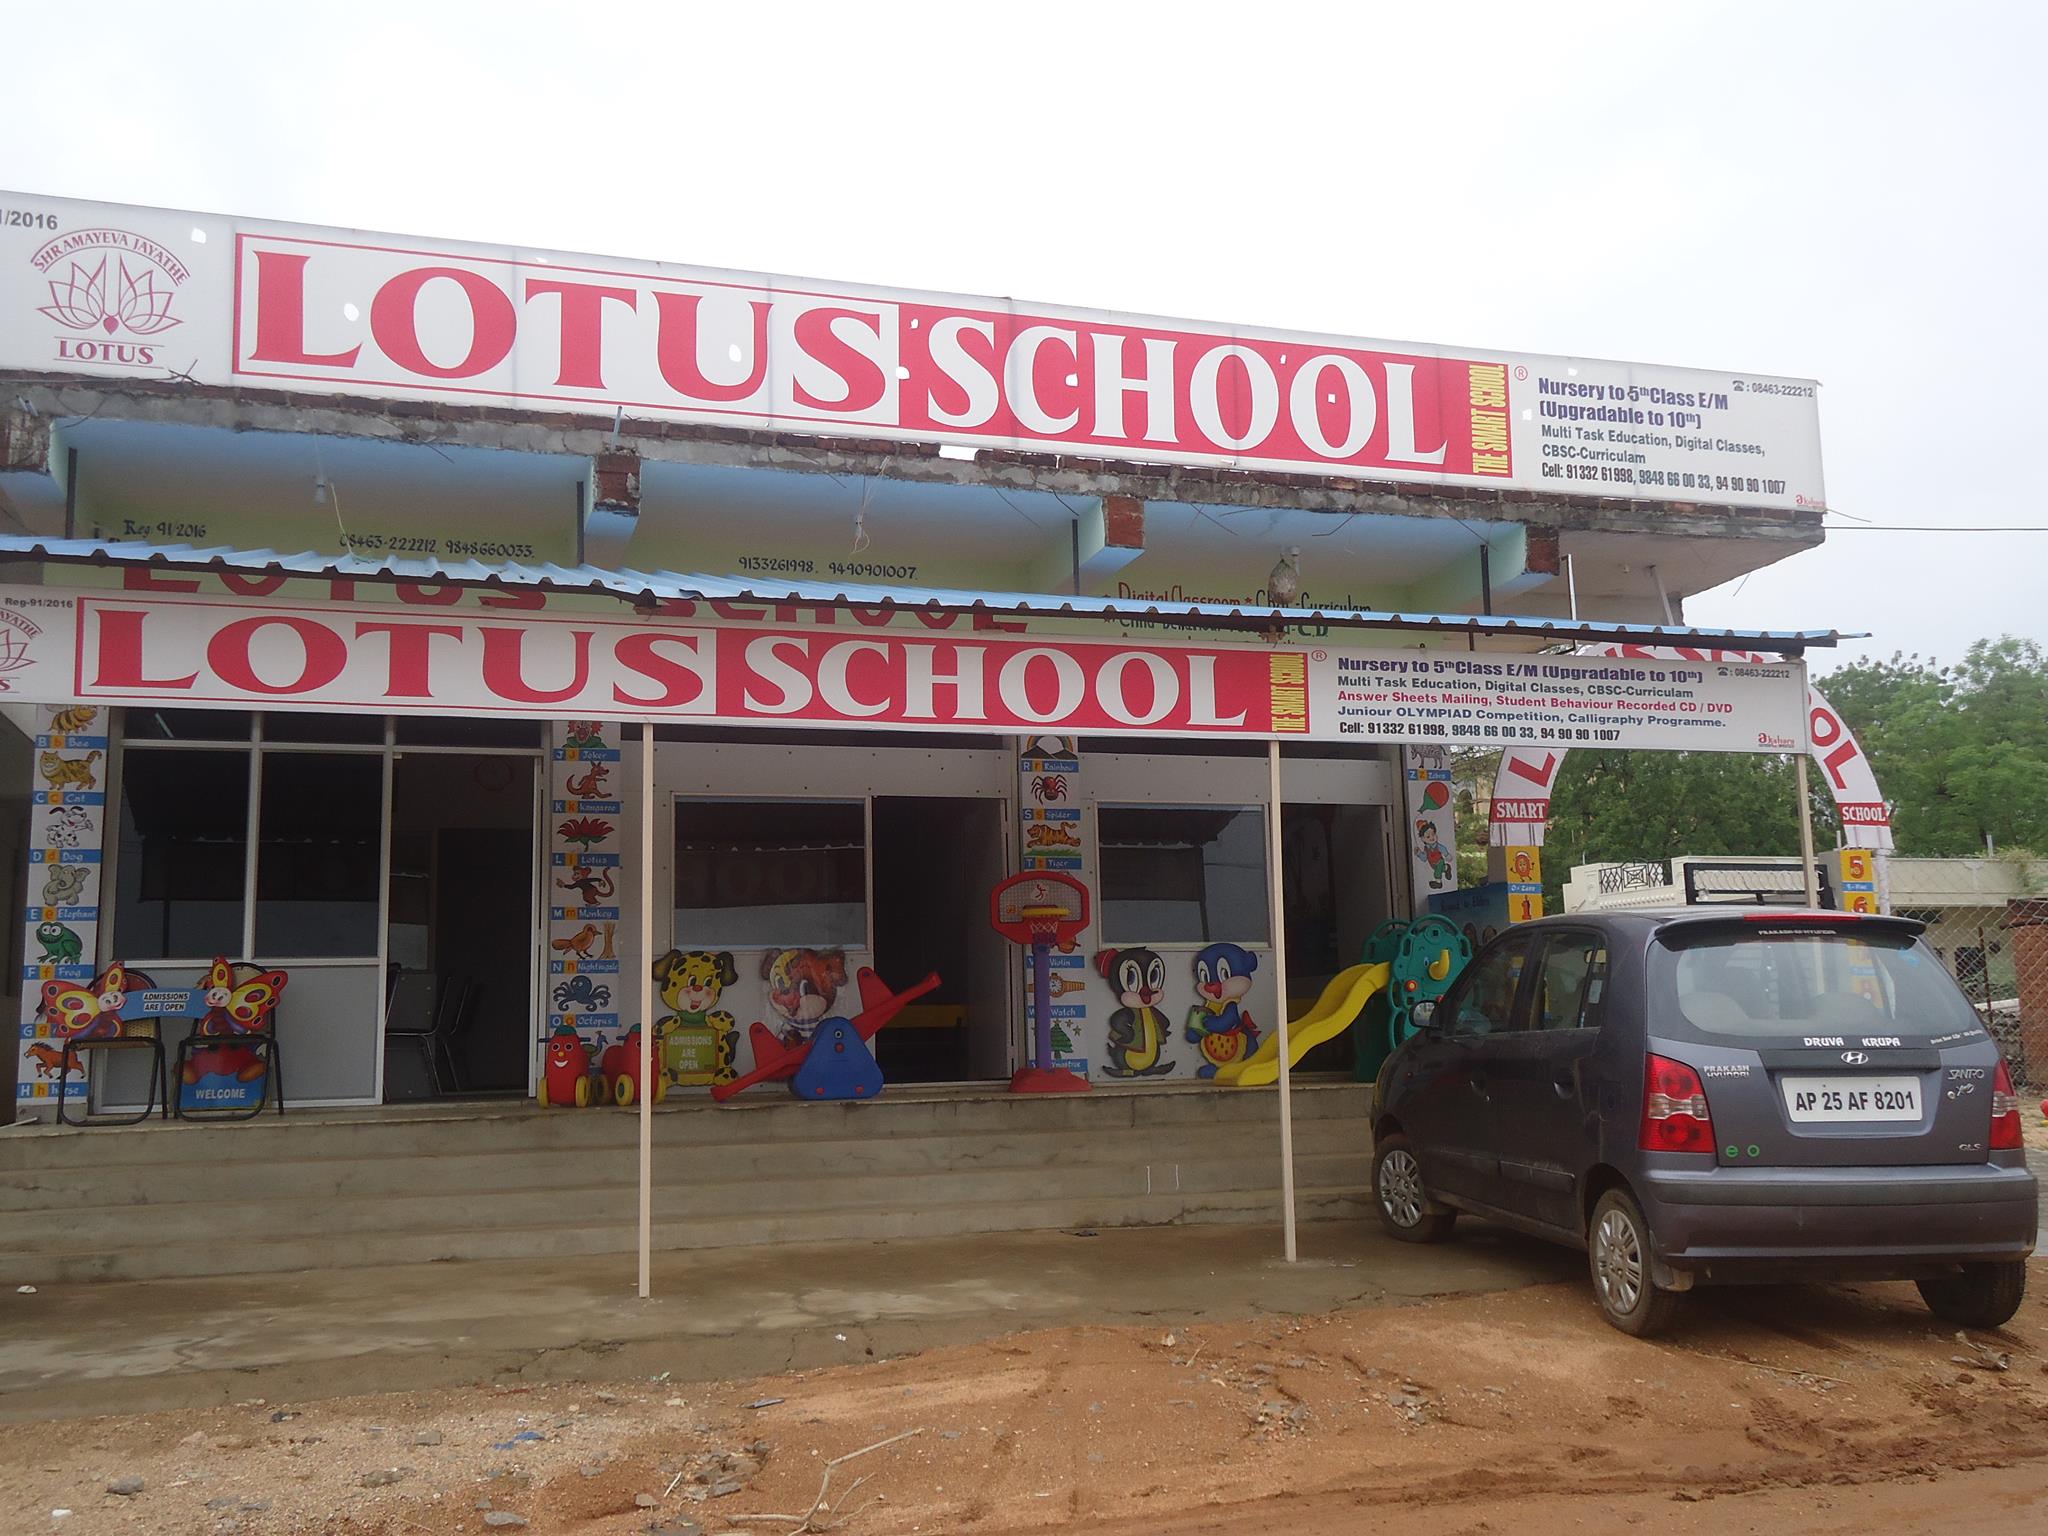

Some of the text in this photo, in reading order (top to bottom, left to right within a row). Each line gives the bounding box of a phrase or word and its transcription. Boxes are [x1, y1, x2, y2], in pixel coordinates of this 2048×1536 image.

[34, 231, 189, 286] SHRAMAYEVA JAYATHE
[59, 340, 155, 365] LOTUS
[247, 250, 1448, 465] LOTUS SCHOOL
[1538, 377, 1605, 401] Nursery
[1609, 385, 1625, 400] to
[1699, 392, 1729, 410] E/M
[1468, 364, 1509, 474] THE SMART SCHOOL
[1648, 411, 1664, 426] to
[1542, 424, 1766, 457] Multi Task Education, Digital Classes,
[1542, 444, 1646, 464] CBSC-Curriculam
[1542, 462, 1786, 494] Cell: 91332 61998, 9848 66 00 33, 94 90 90 1007
[5, 597, 73, 608] Reg-91/2016
[89, 609, 1248, 726] LOTUS SCHOOL
[1338, 657, 1408, 674] Nursery
[1412, 659, 1429, 673] to
[1506, 663, 1538, 677] E/M
[1650, 670, 1666, 682] to
[1338, 676, 1694, 698] Multi Task Education, Digital Classes, CBSC-Curriculam
[1338, 691, 1388, 702] Answer
[1392, 692, 1438, 703] Sheets
[1442, 693, 1492, 706] Mailing,
[1496, 696, 1546, 707] Student
[1551, 698, 1613, 710] Behaviour
[1617, 700, 1677, 711] Recorded
[1680, 702, 1697, 712] CD
[1707, 703, 1733, 713] DVD
[1338, 706, 1726, 727] Juniour OLYMPIAD Competition, Calligraphy Programme.
[1339, 721, 1620, 741] Cell: 91332 61998, 9848 66 00 33, 94 90 90 1007
[583, 750, 608, 759] Joker
[1024, 810, 1032, 820] S
[1496, 802, 1546, 819] SMART
[1842, 806, 1887, 822] SCHOOL
[63, 851, 84, 862] Dog
[58, 909, 97, 921] Elephant
[579, 910, 613, 920] Monkey
[59, 967, 81, 978] Frog
[553, 962, 562, 971] N
[143, 992, 190, 1001] ADMISSIONS
[144, 1002, 186, 1012] ARE OPEN
[577, 1015, 613, 1026] Octopus
[670, 1036, 713, 1046] ADMISSIONS
[1803, 1037, 1901, 1047] DRUVA KRUPA
[681, 1048, 697, 1057] ARE
[679, 1060, 699, 1070] OPEN
[1703, 1064, 1750, 1072] PRAKASH
[1947, 1069, 1985, 1080] SANTRO
[51, 1084, 79, 1095] hrse
[195, 1089, 246, 1099] WELCOME
[1796, 1091, 1915, 1111] AP 25 AF 8201
